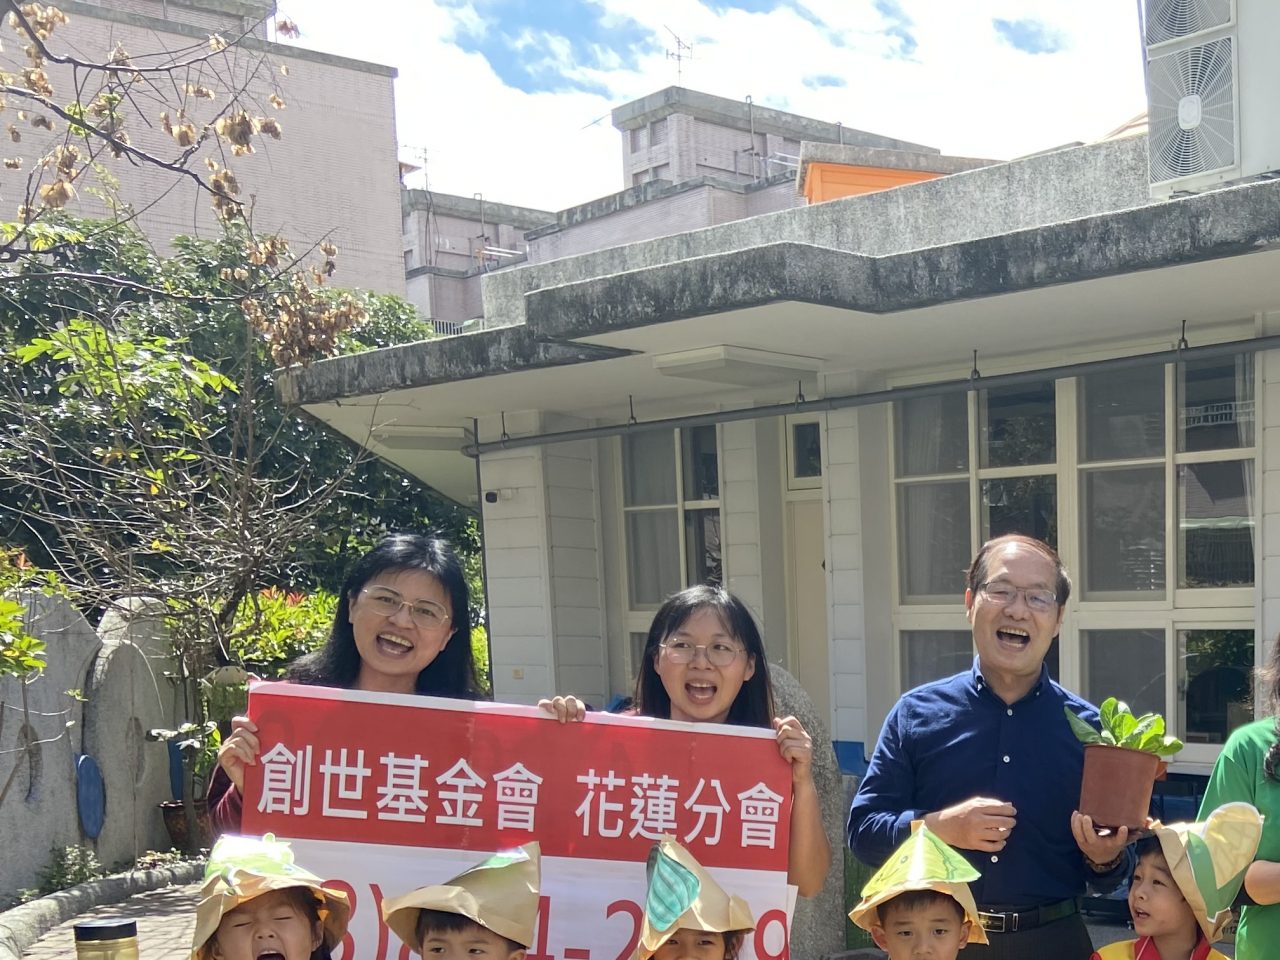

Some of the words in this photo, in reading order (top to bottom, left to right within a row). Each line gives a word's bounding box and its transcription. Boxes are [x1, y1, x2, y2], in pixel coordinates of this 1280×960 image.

[257, 741, 544, 832] 創世基金會
[576, 769, 784, 850] 花蓮分會
